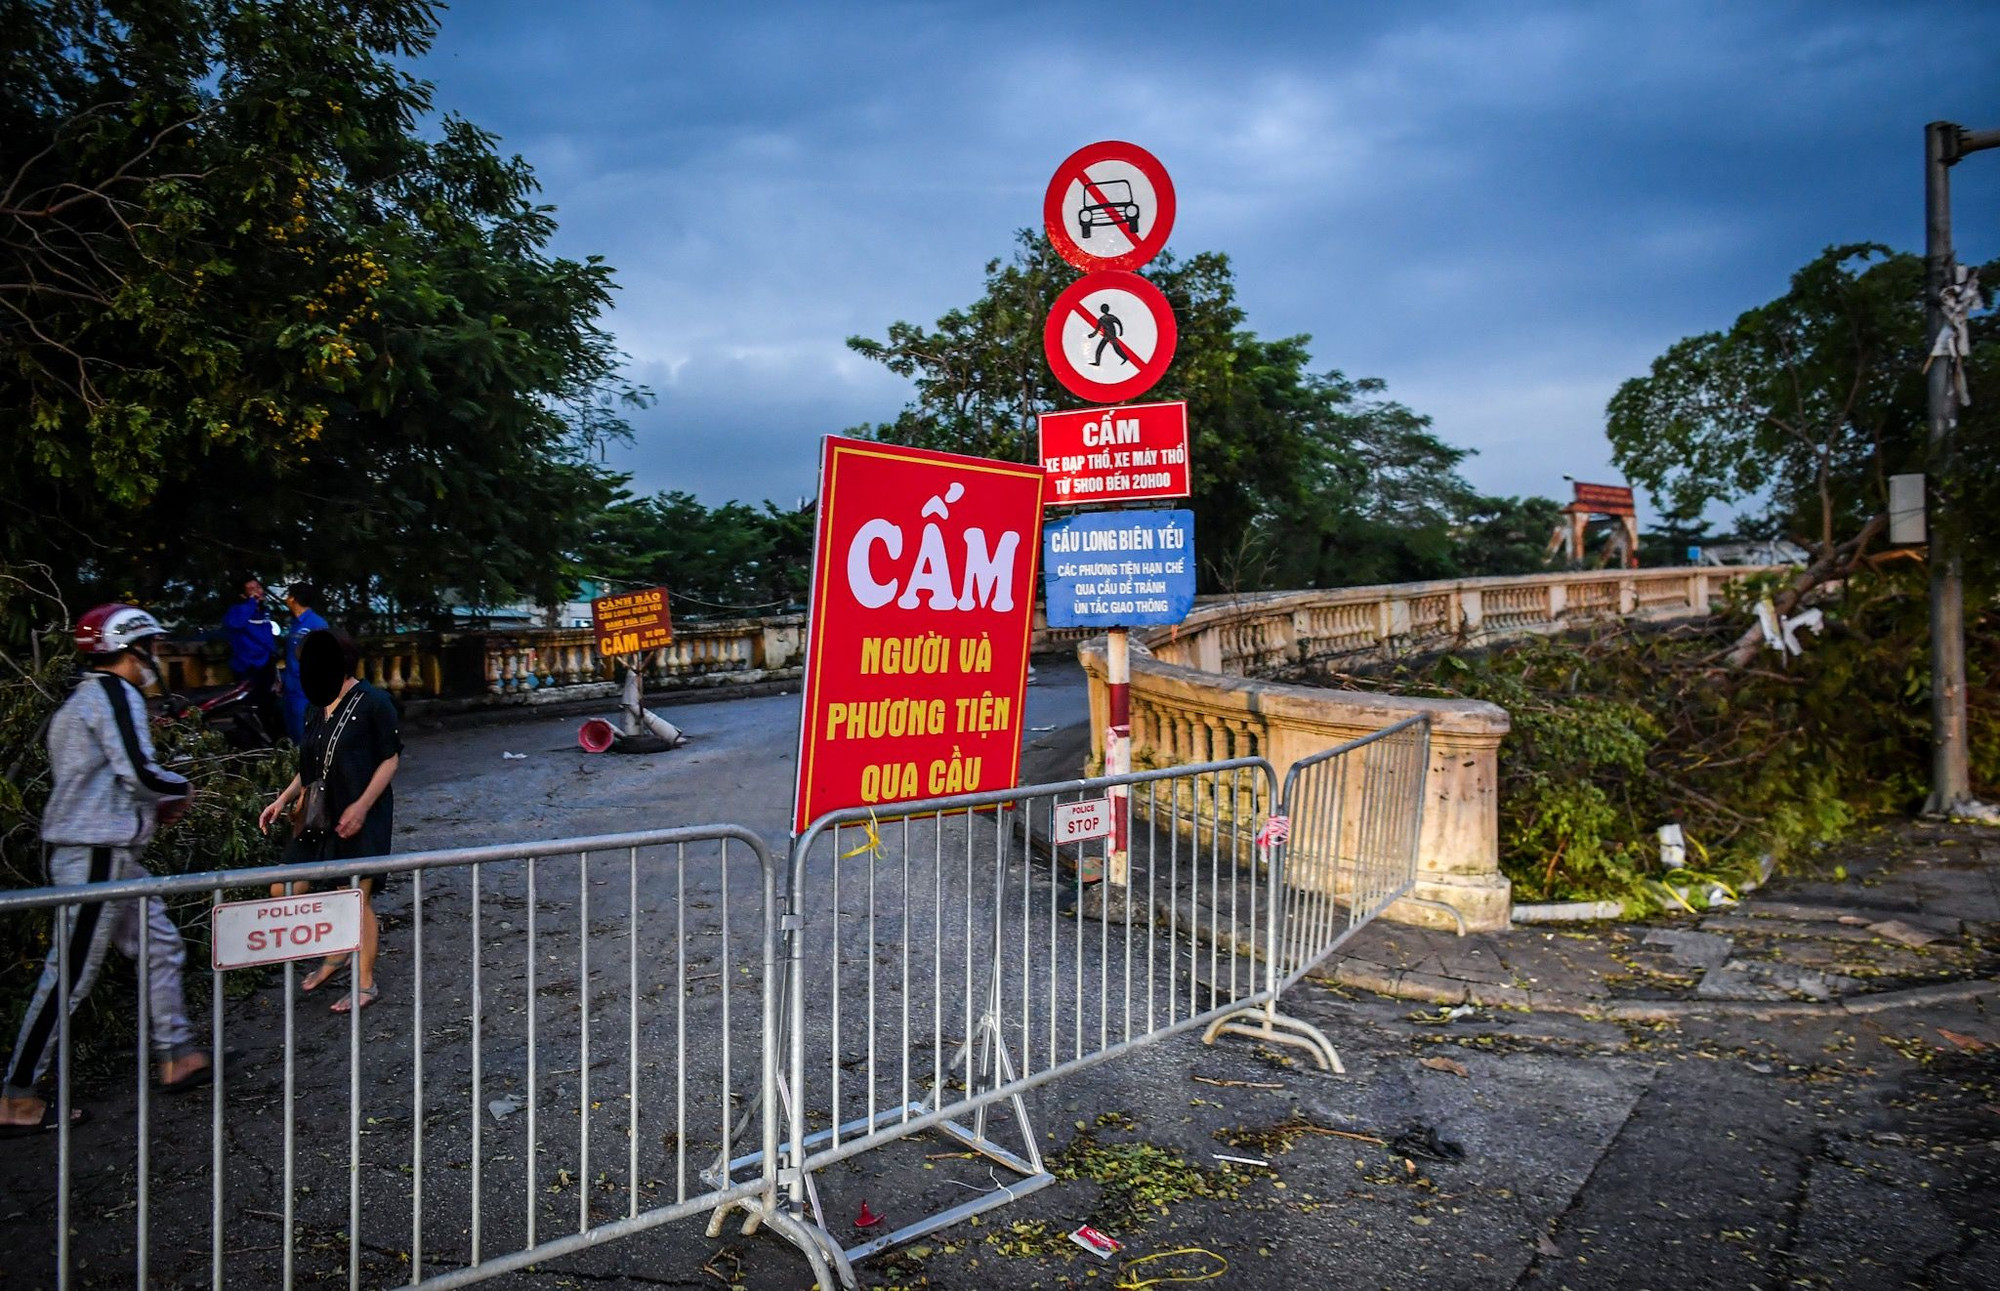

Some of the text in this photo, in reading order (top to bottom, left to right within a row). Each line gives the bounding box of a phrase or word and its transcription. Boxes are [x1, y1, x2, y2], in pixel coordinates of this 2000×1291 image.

[1082, 410, 1140, 447] CẤM
[1045, 457, 1060, 473] XE
[1061, 455, 1085, 475] ĐẠP
[1114, 451, 1130, 468] XE
[1132, 447, 1158, 466] MÁY
[1055, 471, 1171, 495] TỪ 5H00 ĐẾN 20H00
[847, 482, 1021, 613] CẤM
[1051, 521, 1184, 553] CẦU LONG BIÊN YẾU
[1057, 557, 1186, 577] CÁC PHƯƠNG TIỆN HẠN CHẾ
[1075, 583, 1096, 596] QUA
[1097, 578, 1118, 595] CẦU
[1134, 579, 1166, 594] TRÁNH
[1074, 596, 1169, 614] ÙN TẮC GIAO THÔNG
[601, 630, 639, 656] CẤM
[860, 631, 993, 675] NGƯỜI VÀ
[826, 690, 1011, 741] PHƯƠNG TIỆN
[860, 745, 983, 803] QUA CẦU
[1073, 805, 1094, 814] POLICE
[1068, 817, 1099, 834] STOP
[257, 902, 323, 919] POLICE
[247, 922, 333, 951] STOP
